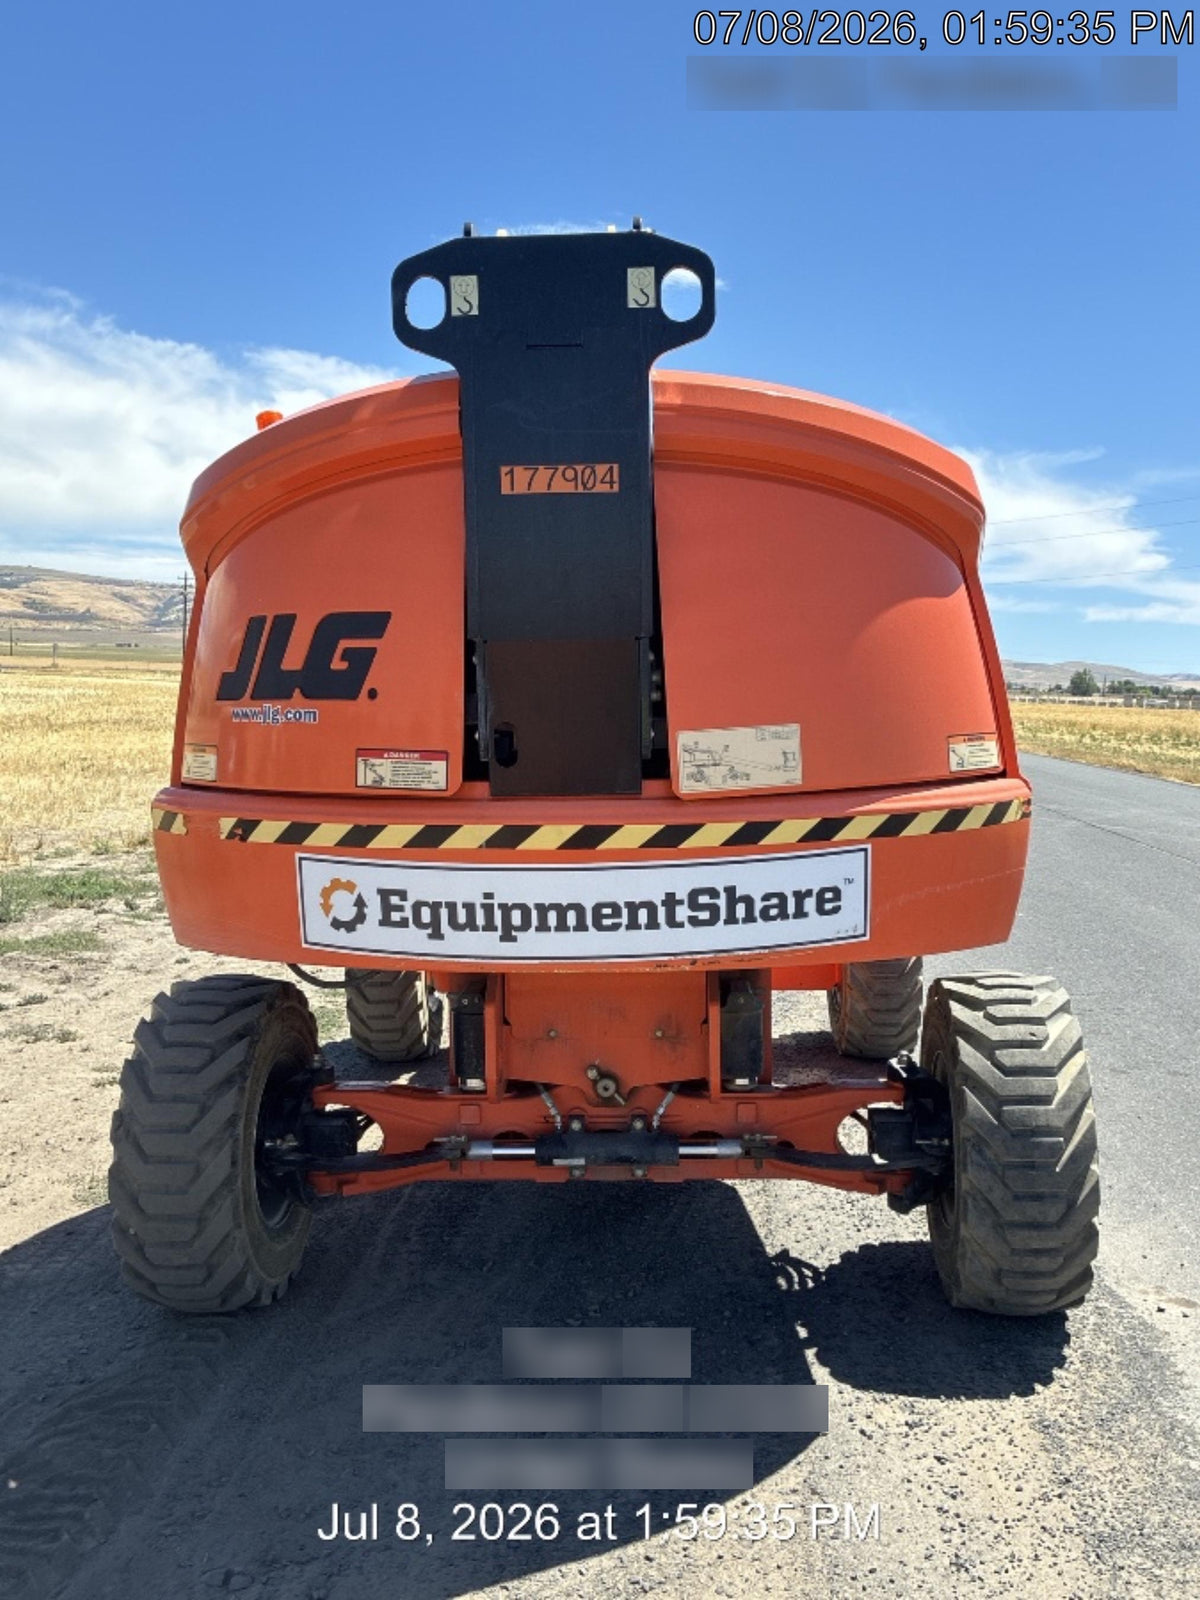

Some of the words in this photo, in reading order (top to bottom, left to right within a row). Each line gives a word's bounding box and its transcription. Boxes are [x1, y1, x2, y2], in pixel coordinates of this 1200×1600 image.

[504, 465, 617, 491] 177904
[231, 704, 318, 725] www.jlg.com
[376, 885, 842, 942] EquipmentShare
